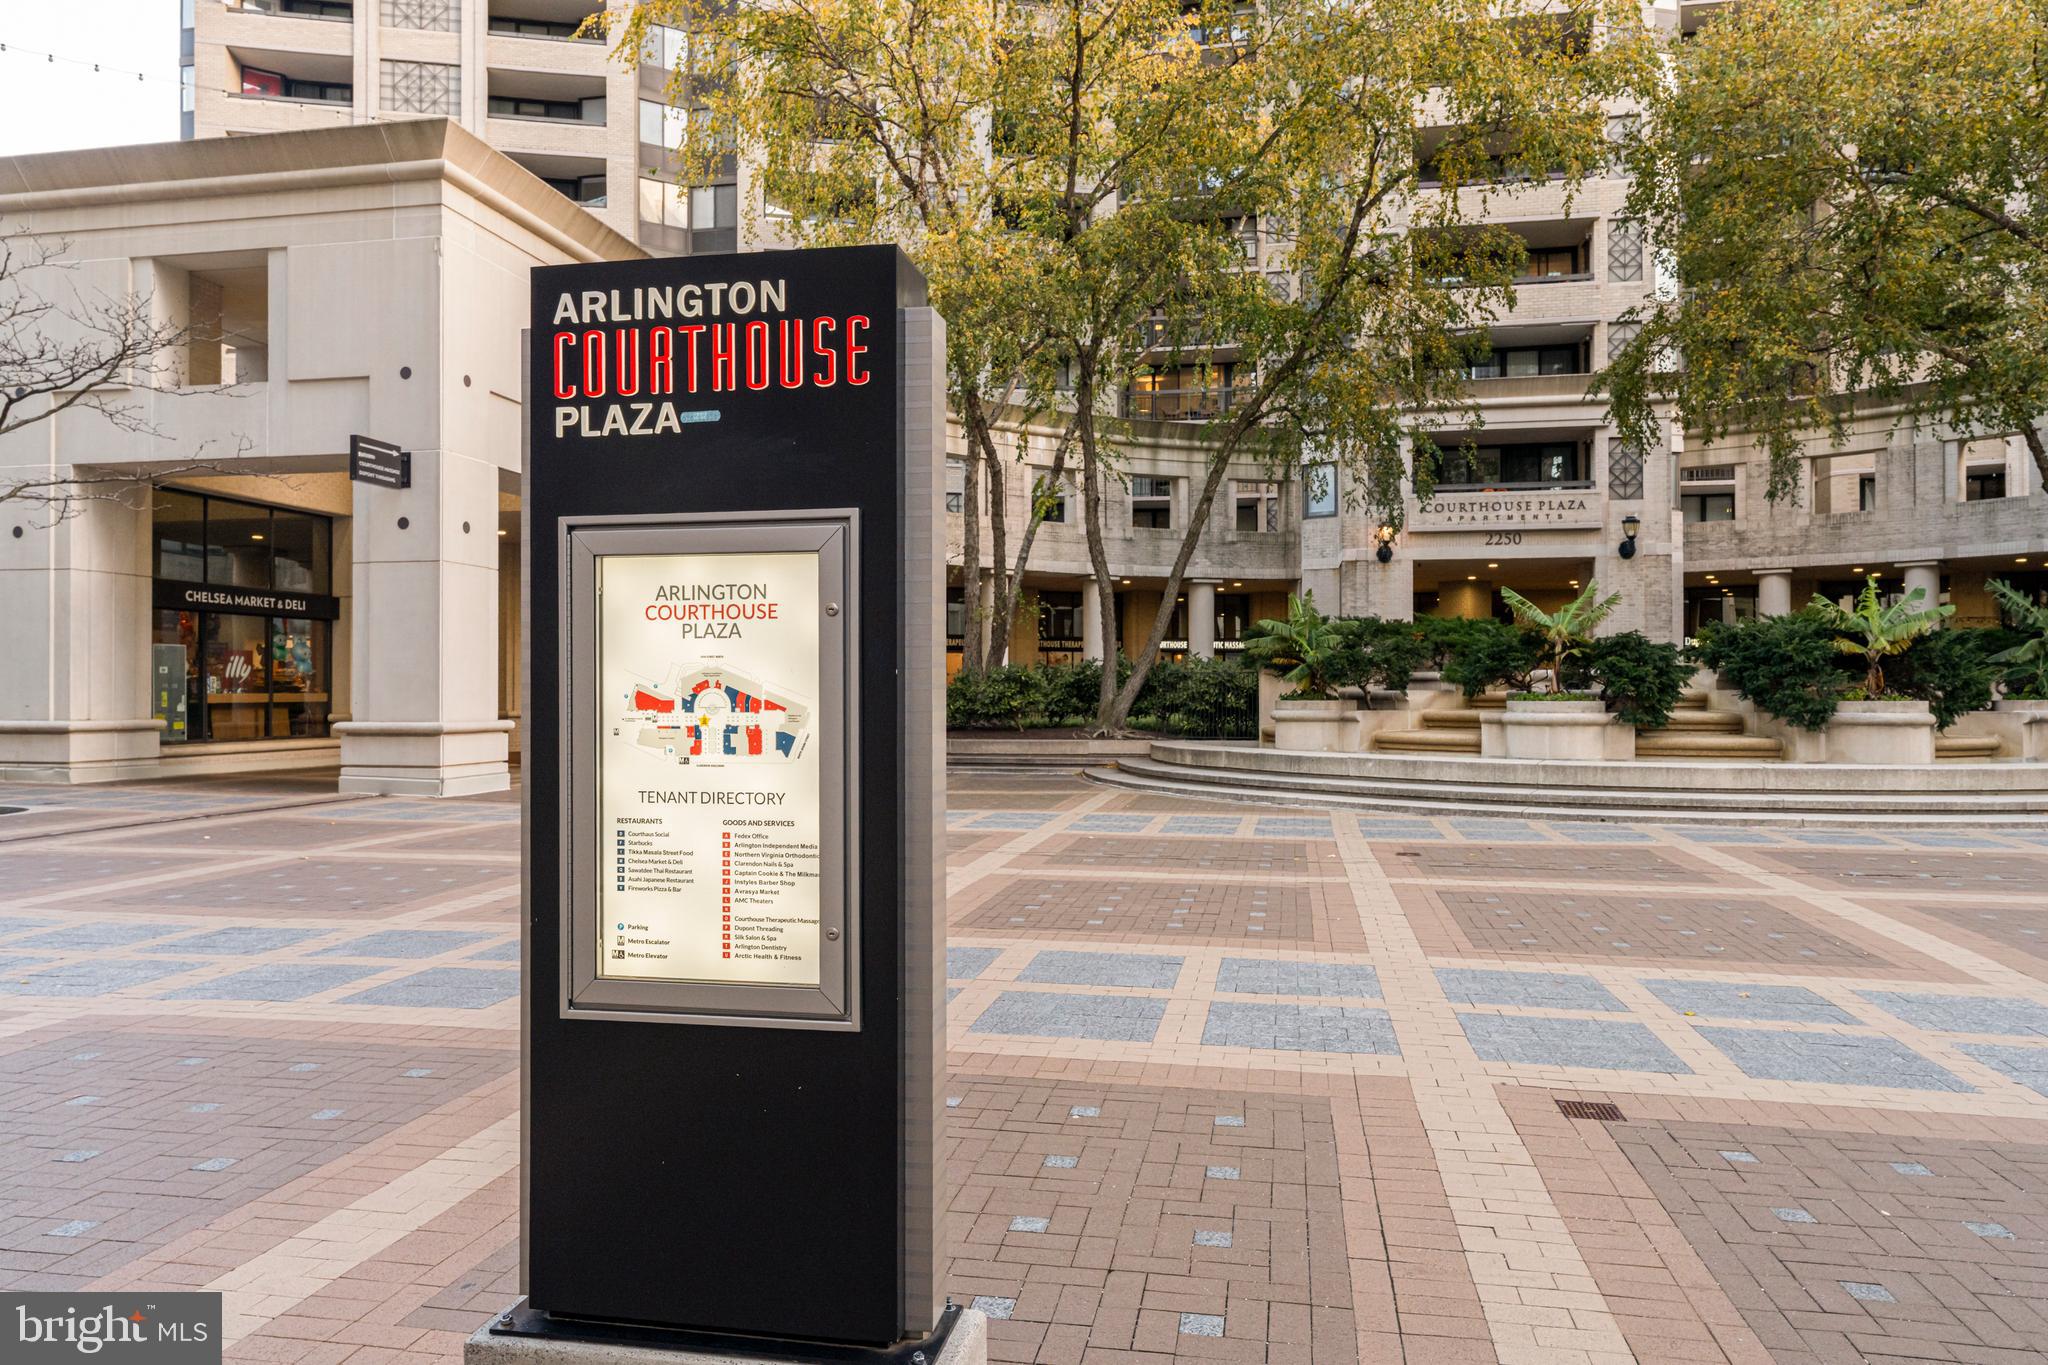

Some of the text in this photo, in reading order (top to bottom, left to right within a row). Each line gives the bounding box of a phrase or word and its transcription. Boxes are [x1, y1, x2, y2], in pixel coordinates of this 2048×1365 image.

[553, 279, 786, 325] ARLINGTON
[554, 315, 870, 399] COURTHOUSE
[555, 402, 682, 438] PLAZA
[1424, 499, 1586, 514] COURTHOUSE PLAZA
[1447, 514, 1563, 522] APARTMENTS
[1485, 532, 1522, 546] 2250
[655, 584, 767, 600] ARLINGTON
[185, 590, 306, 611] CHELSEA MARKET & DELI
[645, 604, 778, 620] COURTHOUSE
[682, 623, 742, 639] PLAZA
[225, 655, 252, 683] illy
[638, 790, 786, 806] TENANT DIRECTORY
[756, 925, 784, 933] Threading
